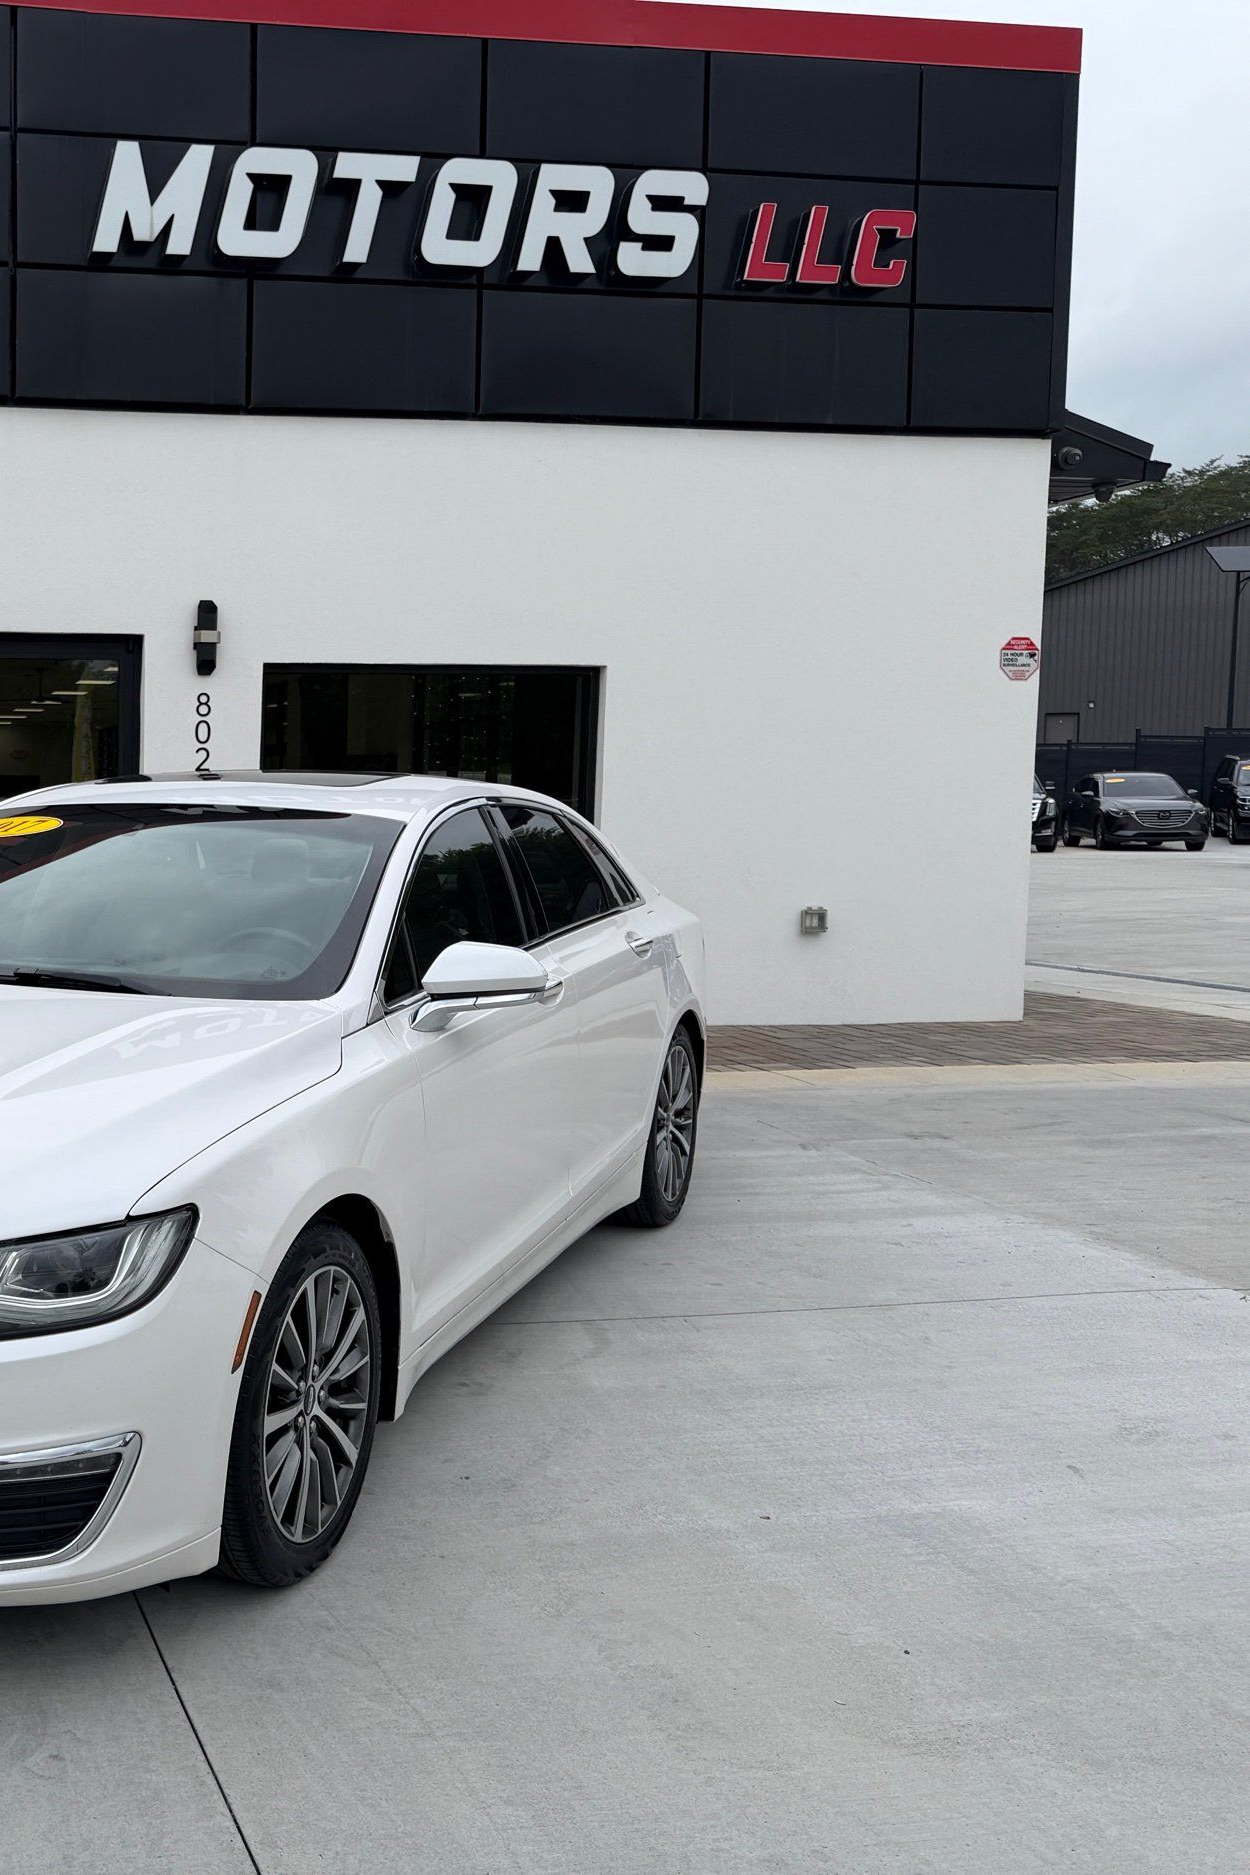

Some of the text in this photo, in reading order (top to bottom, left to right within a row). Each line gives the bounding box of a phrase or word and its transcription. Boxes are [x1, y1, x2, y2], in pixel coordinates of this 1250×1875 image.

[91, 140, 708, 277] MOTORS
[743, 203, 917, 288] LLC
[195, 692, 211, 772] 802
